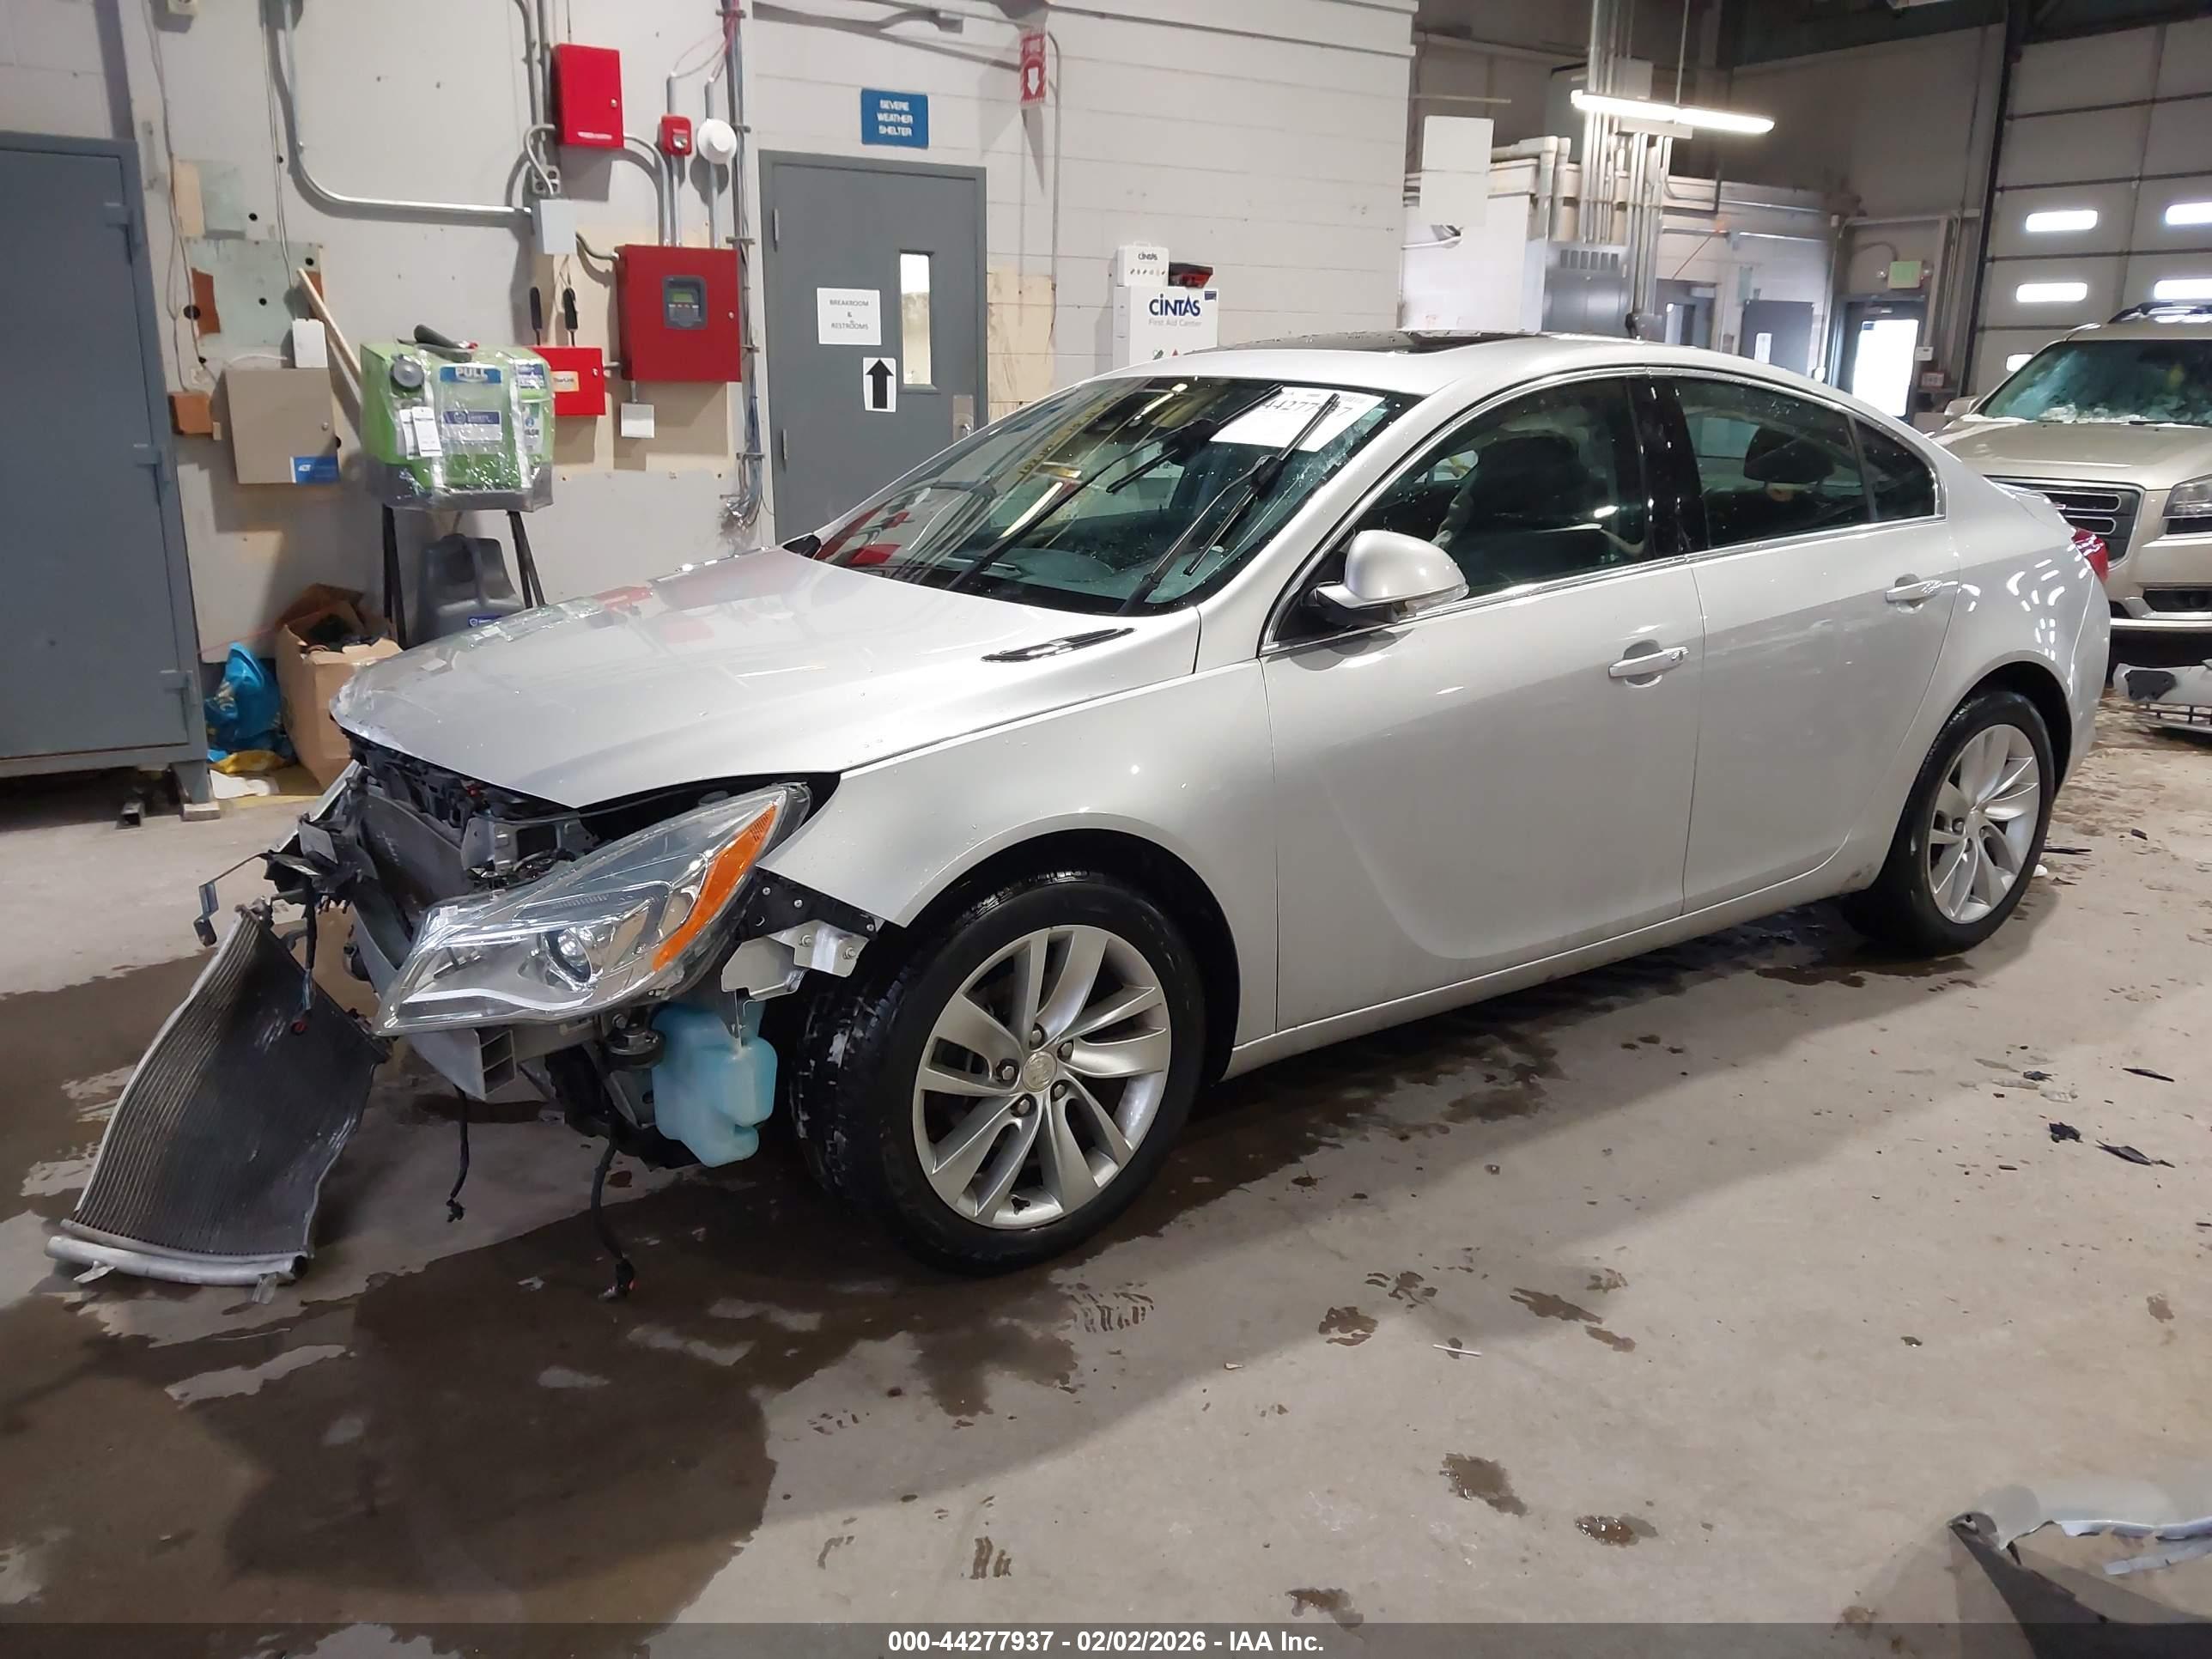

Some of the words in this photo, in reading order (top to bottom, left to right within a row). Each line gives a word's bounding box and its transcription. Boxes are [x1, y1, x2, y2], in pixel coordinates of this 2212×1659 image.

[877, 112, 914, 125] WEATHER
[878, 125, 913, 137] SHELTER
[830, 322, 869, 331] RESTROOMS
[1179, 319, 1202, 327] Center
[455, 366, 488, 379] PULL
